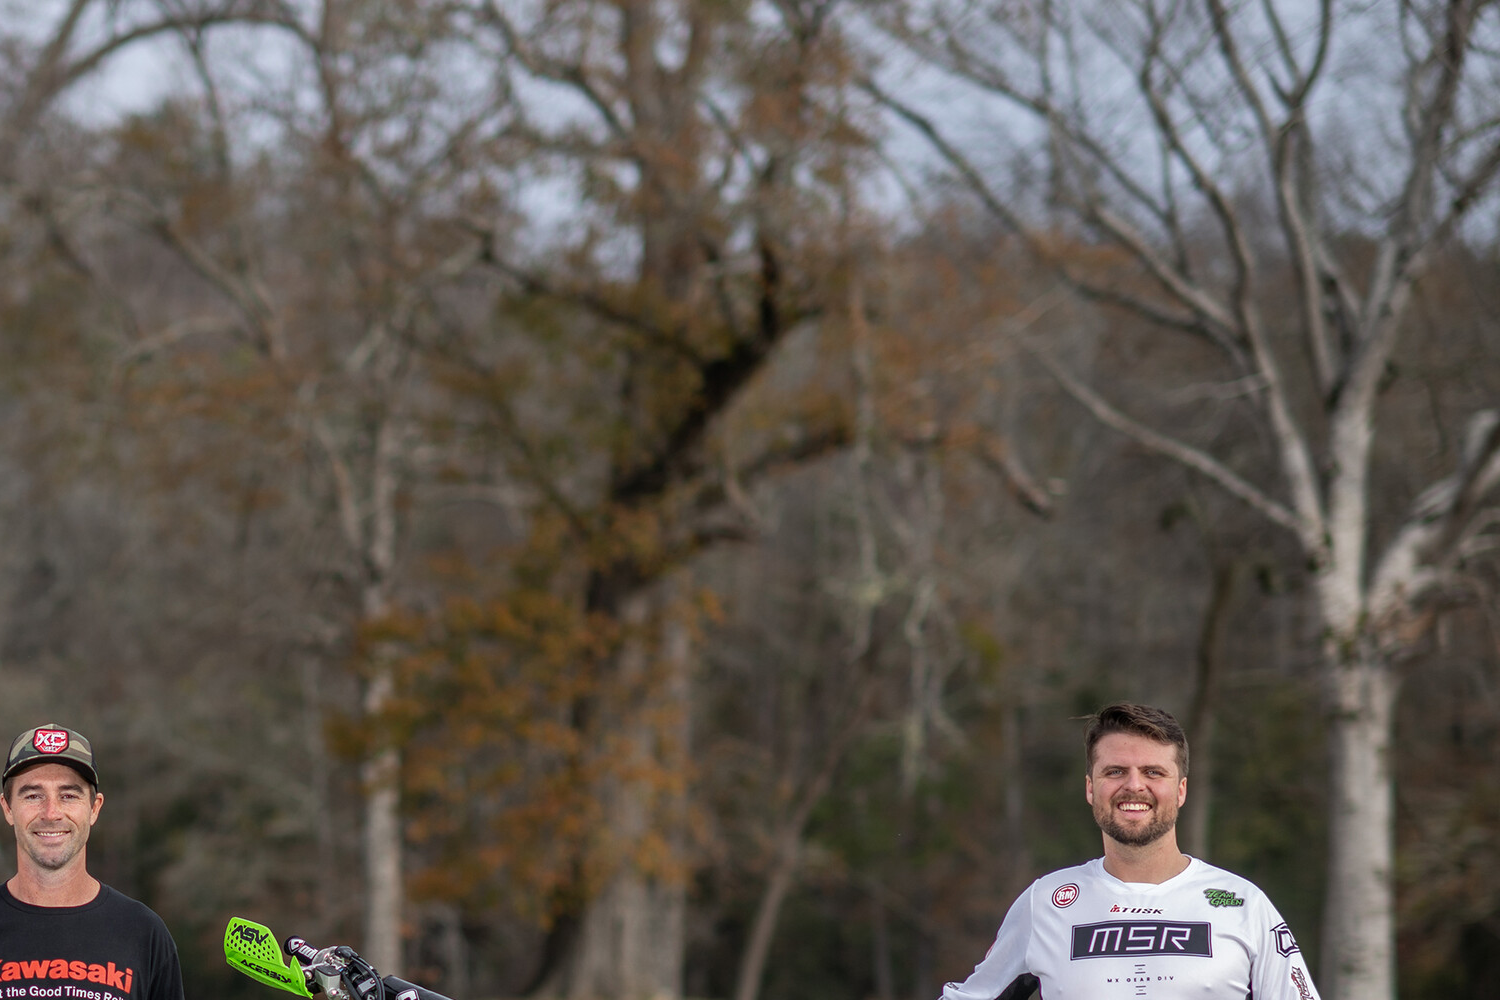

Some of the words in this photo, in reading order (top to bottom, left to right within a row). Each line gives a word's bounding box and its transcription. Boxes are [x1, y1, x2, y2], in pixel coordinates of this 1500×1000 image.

[1204, 888, 1236, 899] TEAM
[1208, 897, 1244, 908] GREEN
[1120, 907, 1164, 915] TUSK
[231, 925, 269, 945] ASV
[1088, 926, 1192, 953] MSR
[240, 959, 292, 984] ACERBIS
[6, 986, 27, 998] the
[29, 985, 62, 997] Good
[64, 985, 101, 1000] Times
